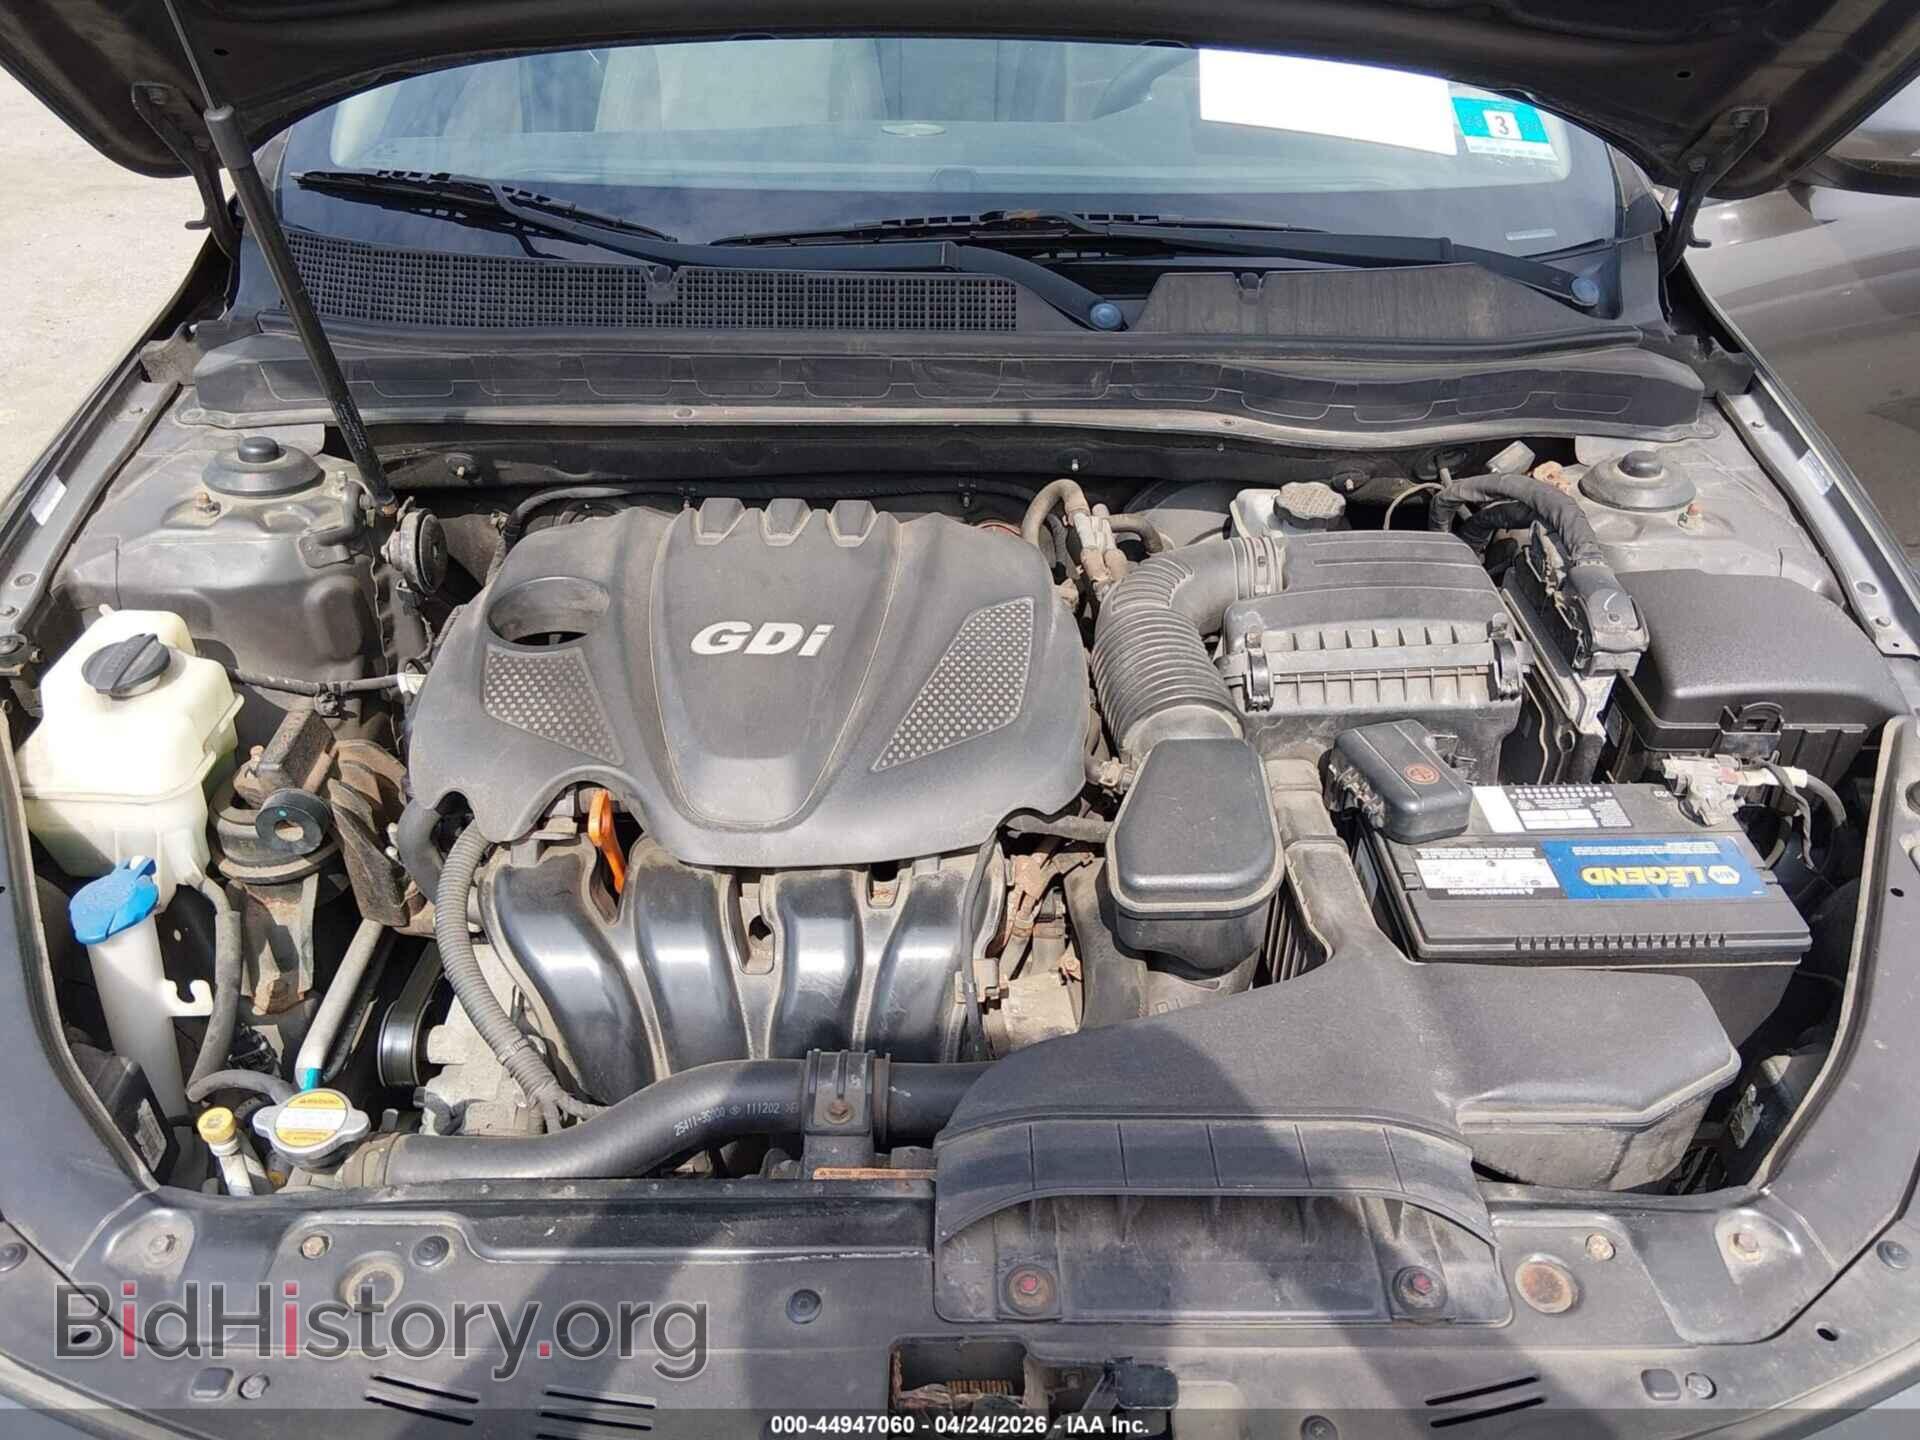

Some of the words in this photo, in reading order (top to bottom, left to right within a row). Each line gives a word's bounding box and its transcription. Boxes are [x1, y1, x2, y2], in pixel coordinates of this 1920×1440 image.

[1494, 115, 1510, 136] 3
[690, 620, 835, 657] GDi
[1582, 865, 1706, 887] LEGEND
